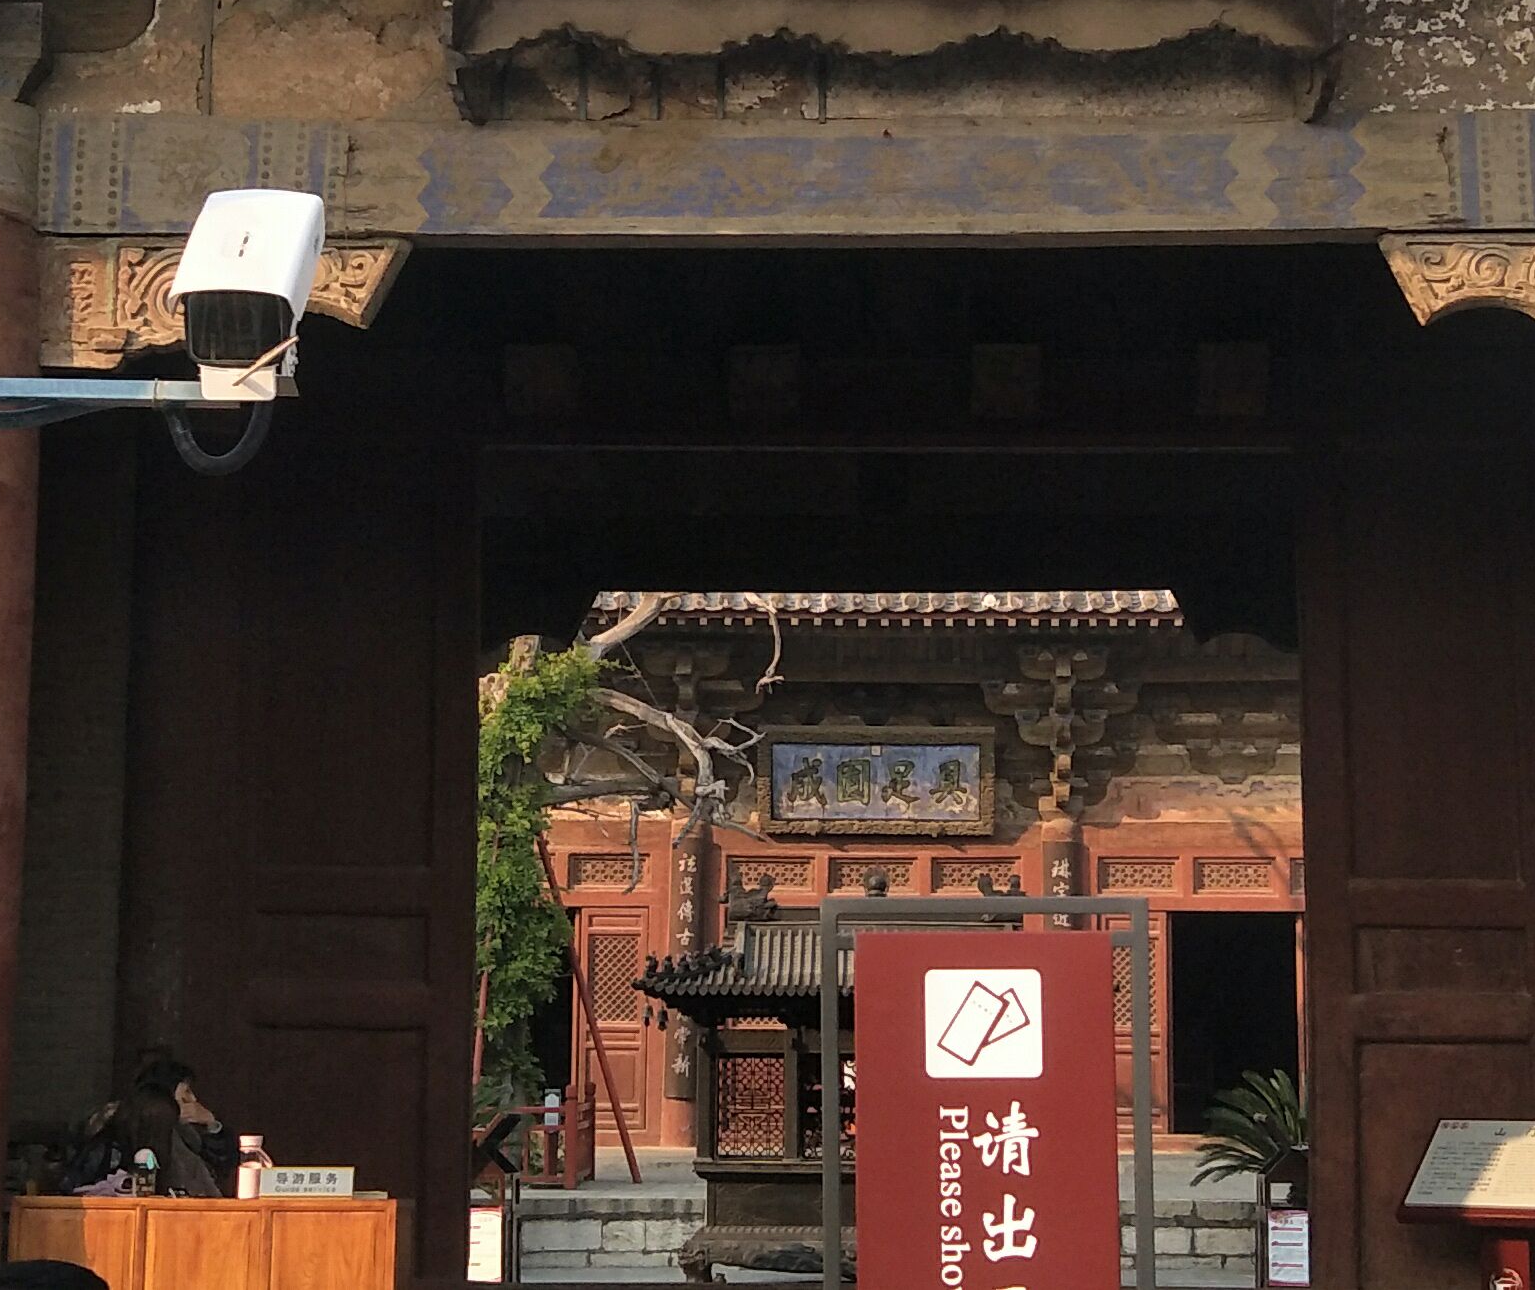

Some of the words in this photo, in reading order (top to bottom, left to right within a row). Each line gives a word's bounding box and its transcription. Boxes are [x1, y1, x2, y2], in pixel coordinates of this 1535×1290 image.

[275, 1171, 338, 1185] 导游服务
[938, 1104, 970, 1218] Please
[972, 1100, 1040, 1290] 请出
[940, 1225, 972, 1290] sho
